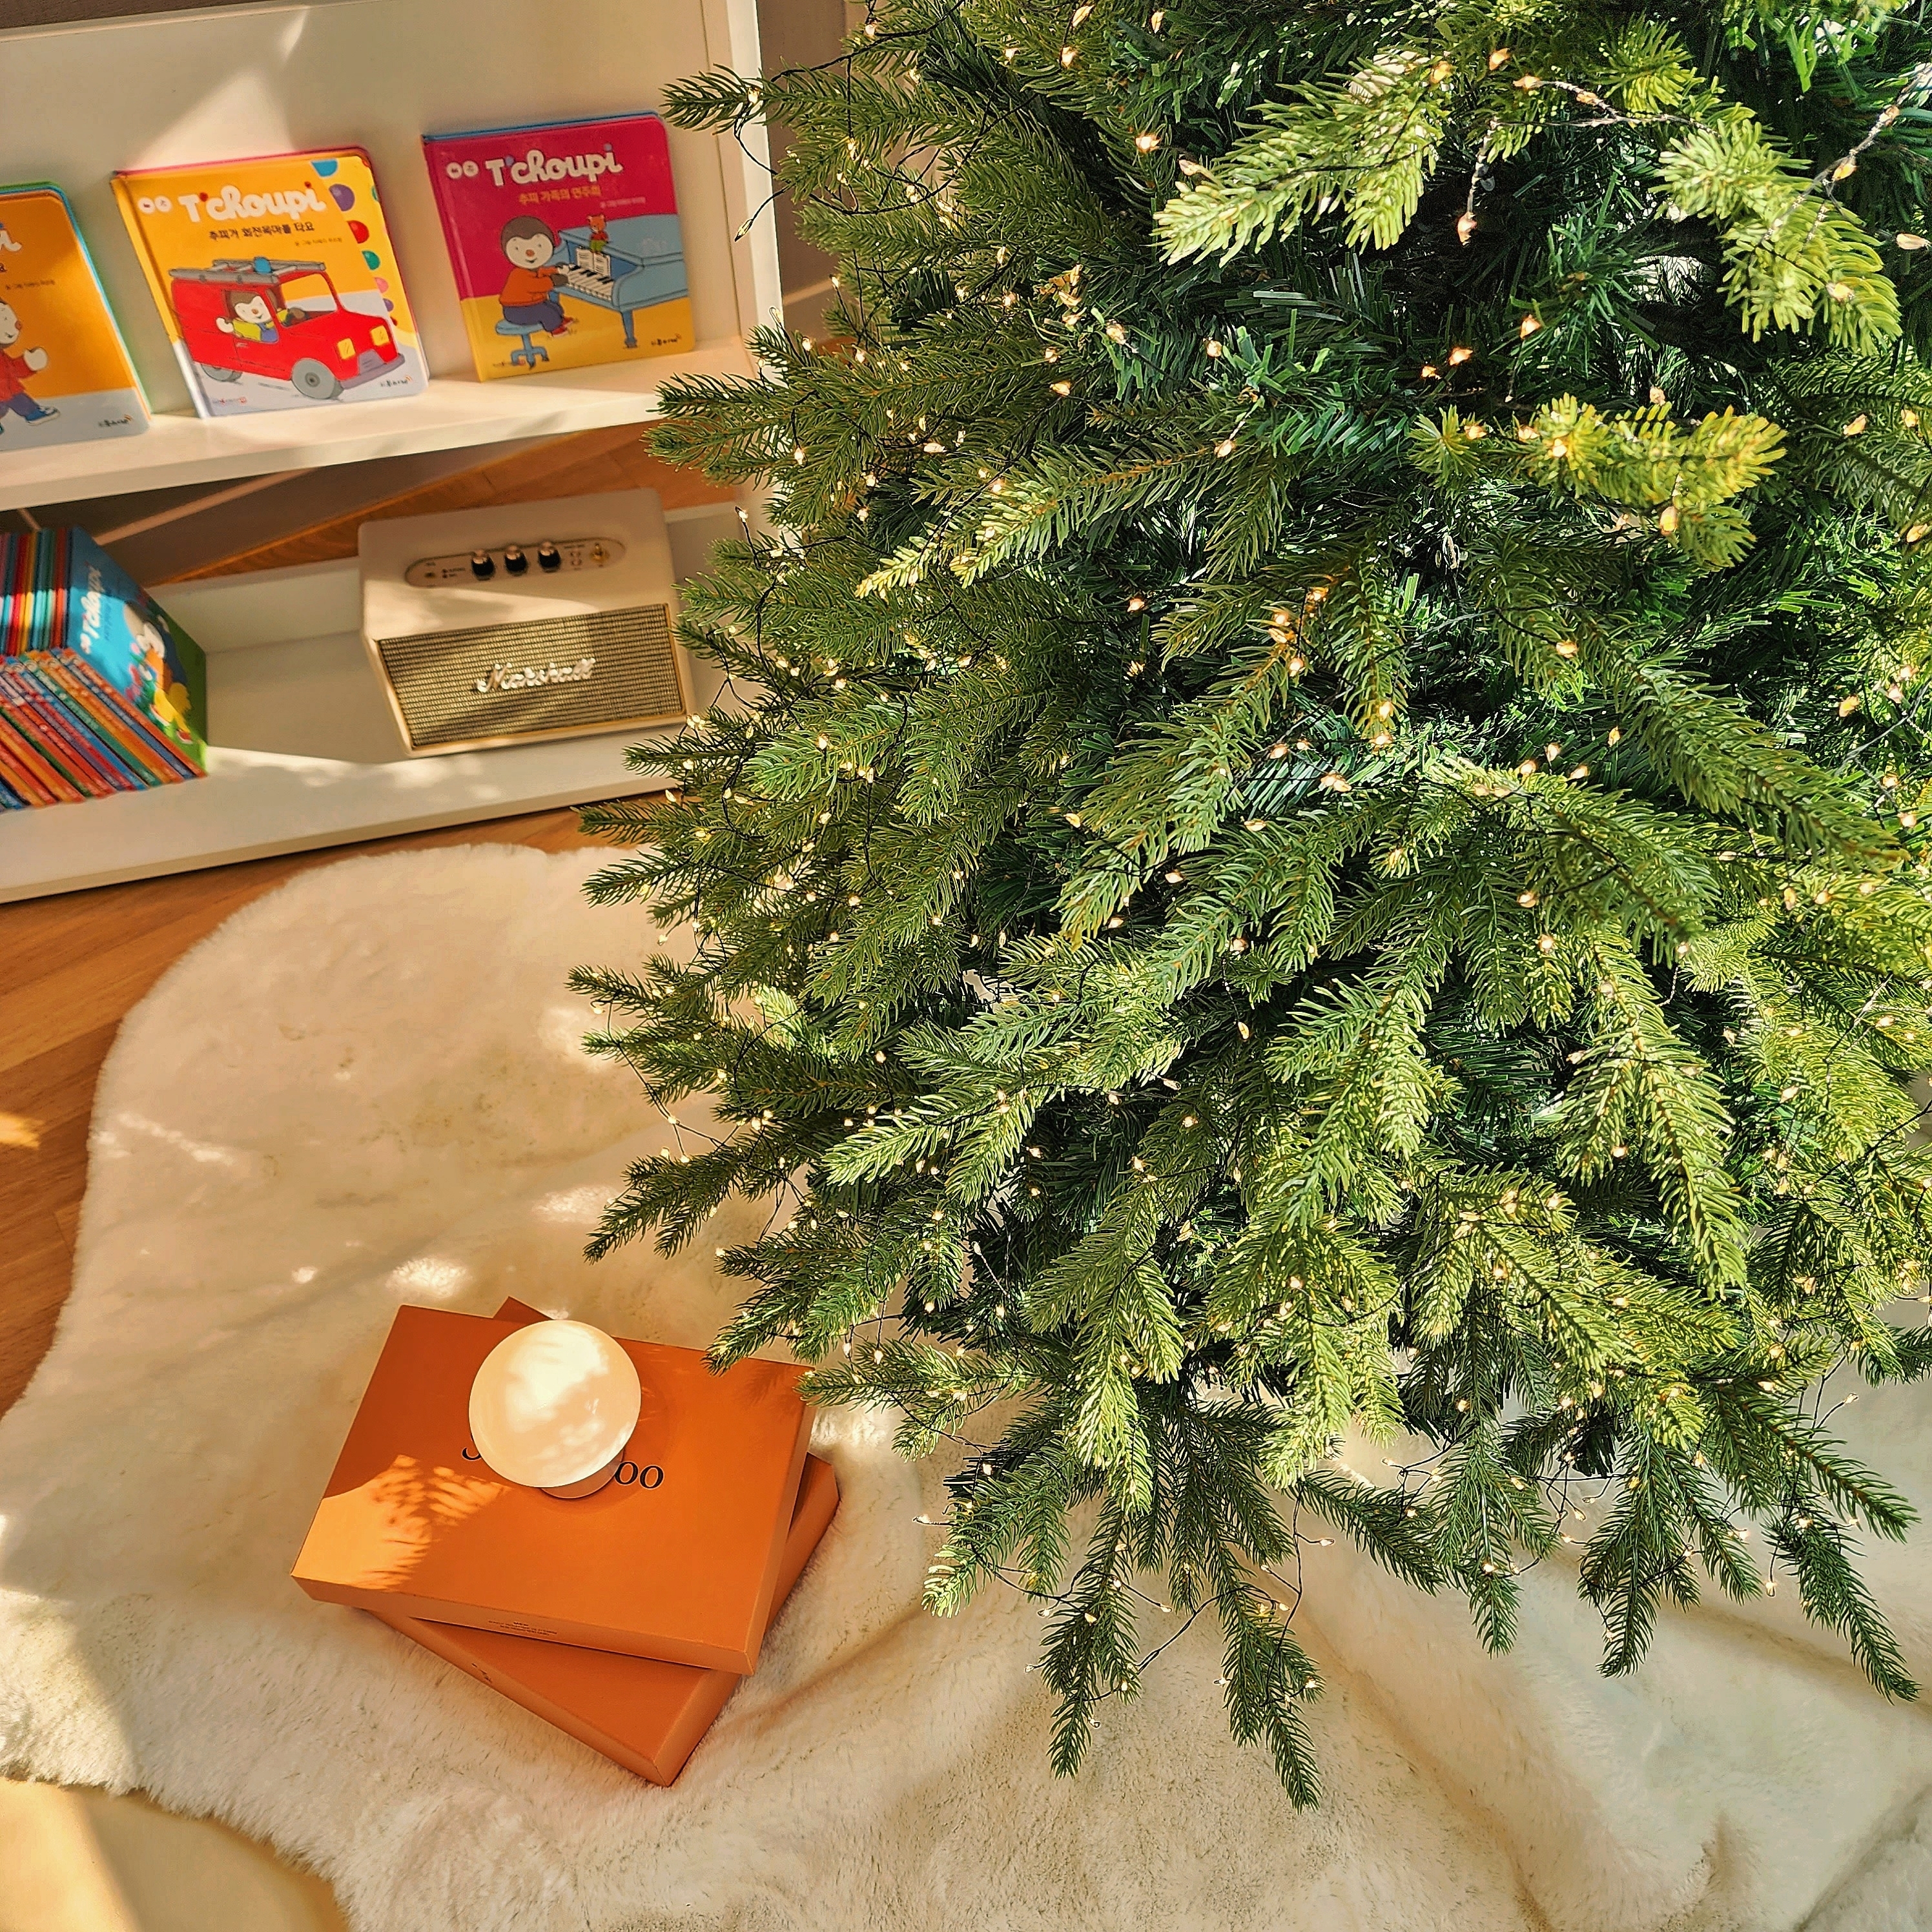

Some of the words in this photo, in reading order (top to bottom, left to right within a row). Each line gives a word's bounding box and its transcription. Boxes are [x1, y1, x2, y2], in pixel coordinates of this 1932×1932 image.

[486, 143, 624, 187] T'choupi
[178, 180, 327, 223] T'choupi
[477, 657, 596, 693] Marshall
